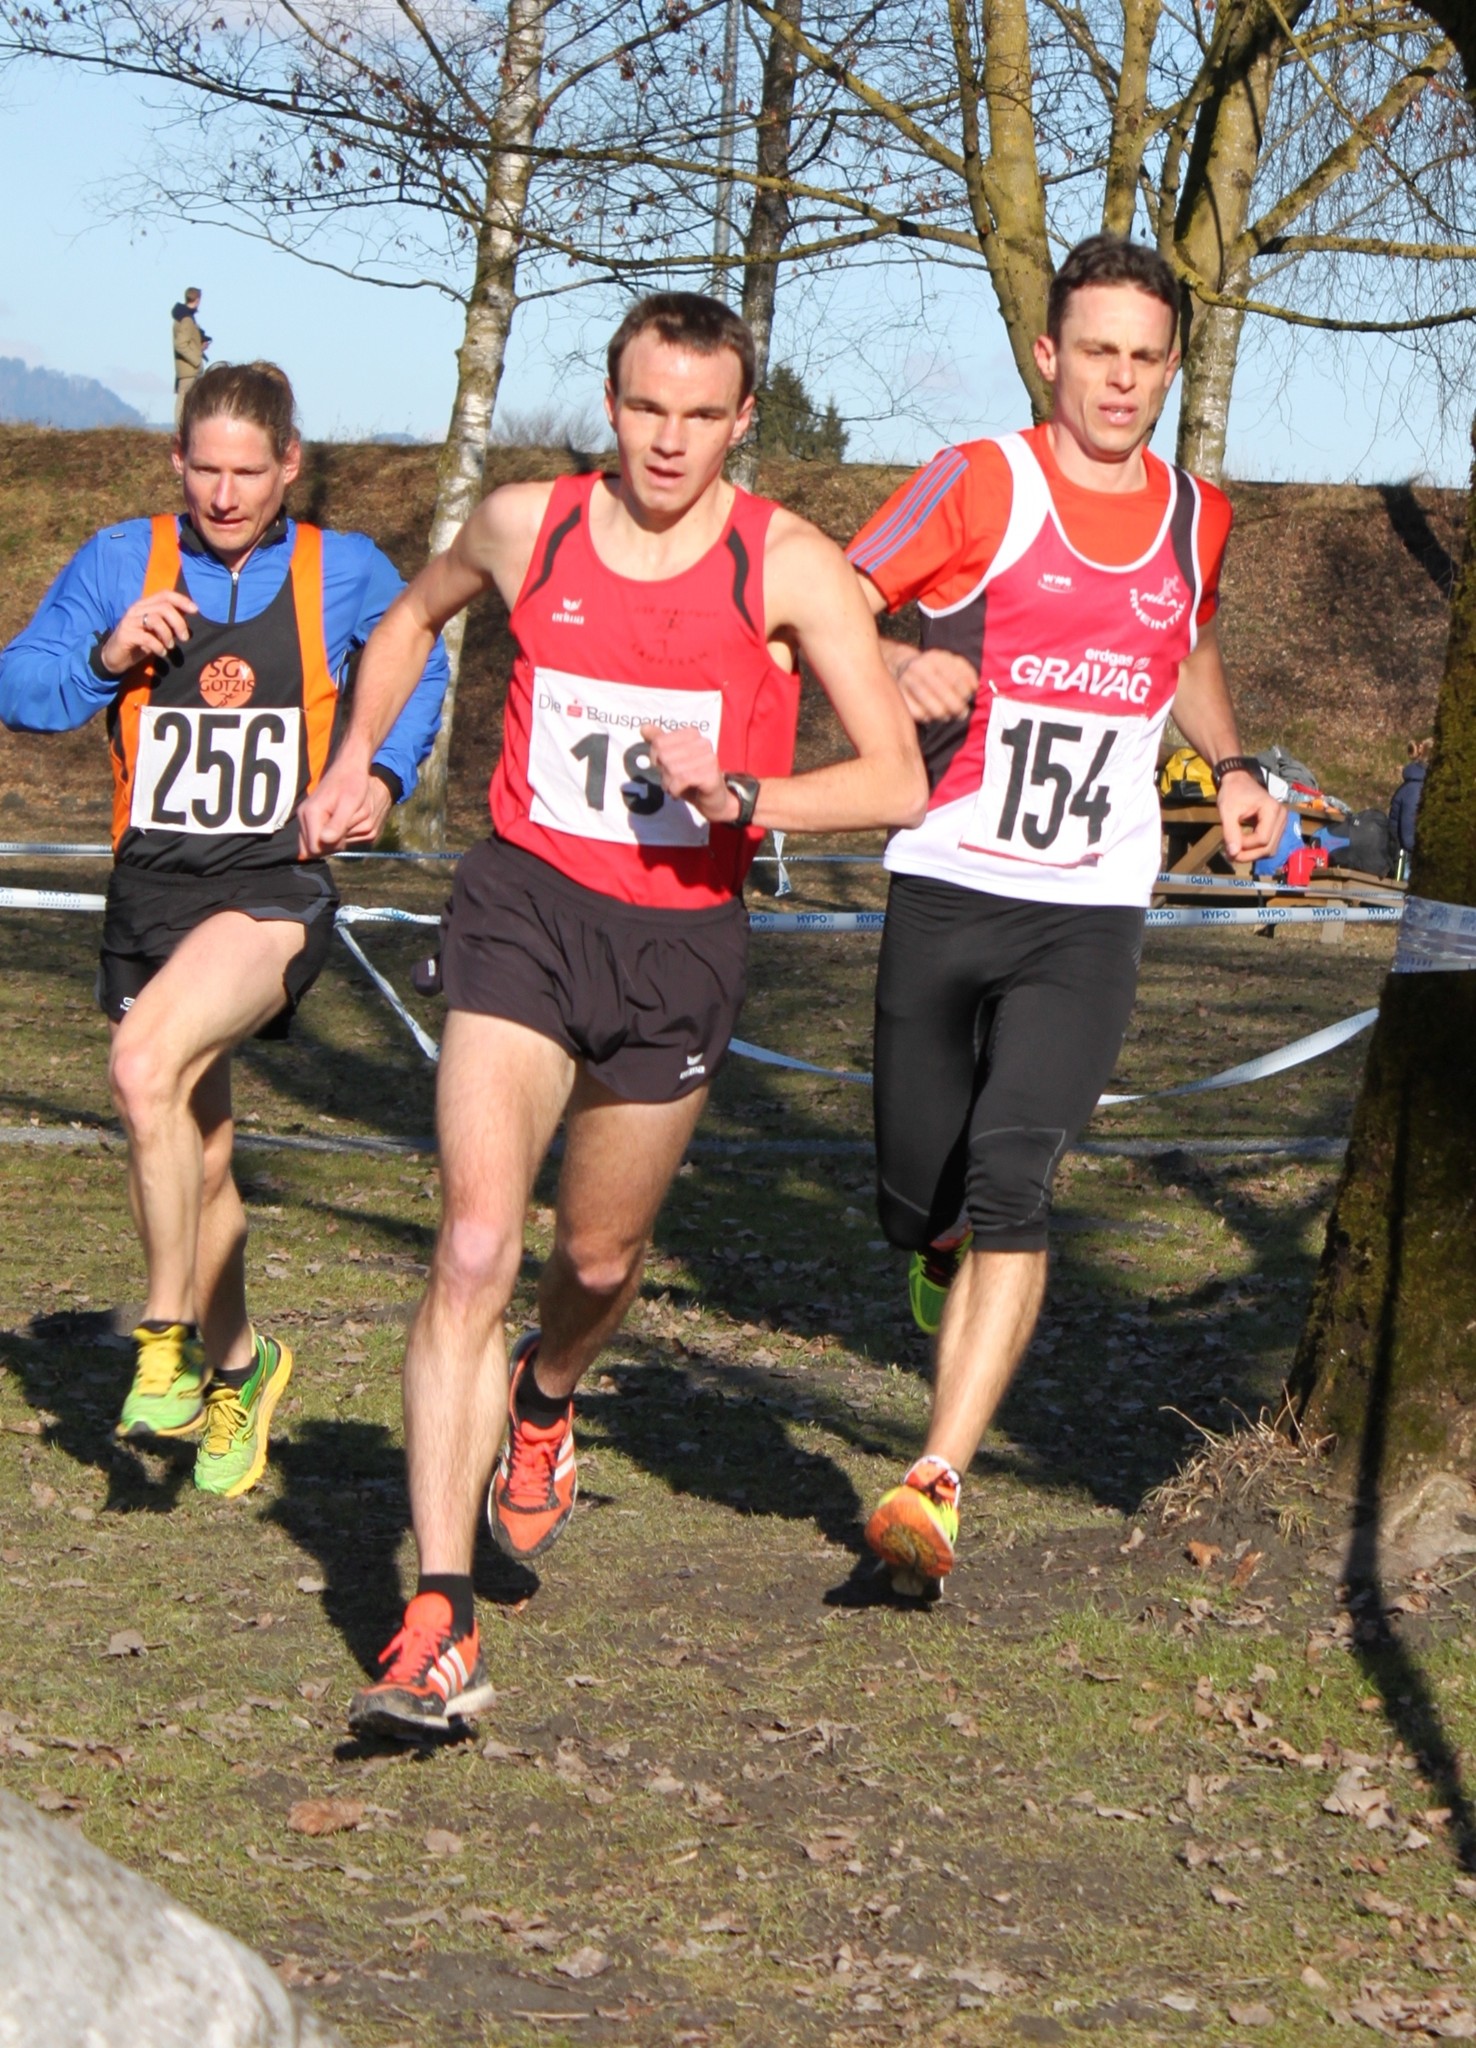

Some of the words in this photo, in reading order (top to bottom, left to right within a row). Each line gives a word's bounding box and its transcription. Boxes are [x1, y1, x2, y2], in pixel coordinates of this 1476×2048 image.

[1084, 647, 1134, 667] erdgas
[208, 659, 241, 678] SG
[1010, 654, 1152, 704] GRAVAG
[538, 693, 562, 713] Die
[586, 705, 710, 733] Bausparkasse
[151, 711, 286, 829] 256
[996, 718, 1119, 850] 154
[1191, 876, 1213, 886] HYPO
[796, 914, 828, 924] HYPO
[1146, 910, 1175, 920] HYPO
[1202, 910, 1231, 919] HYPO
[1257, 909, 1287, 918] HYPO
[1313, 908, 1341, 916] HYPO
[1368, 907, 1396, 915] HYPO
